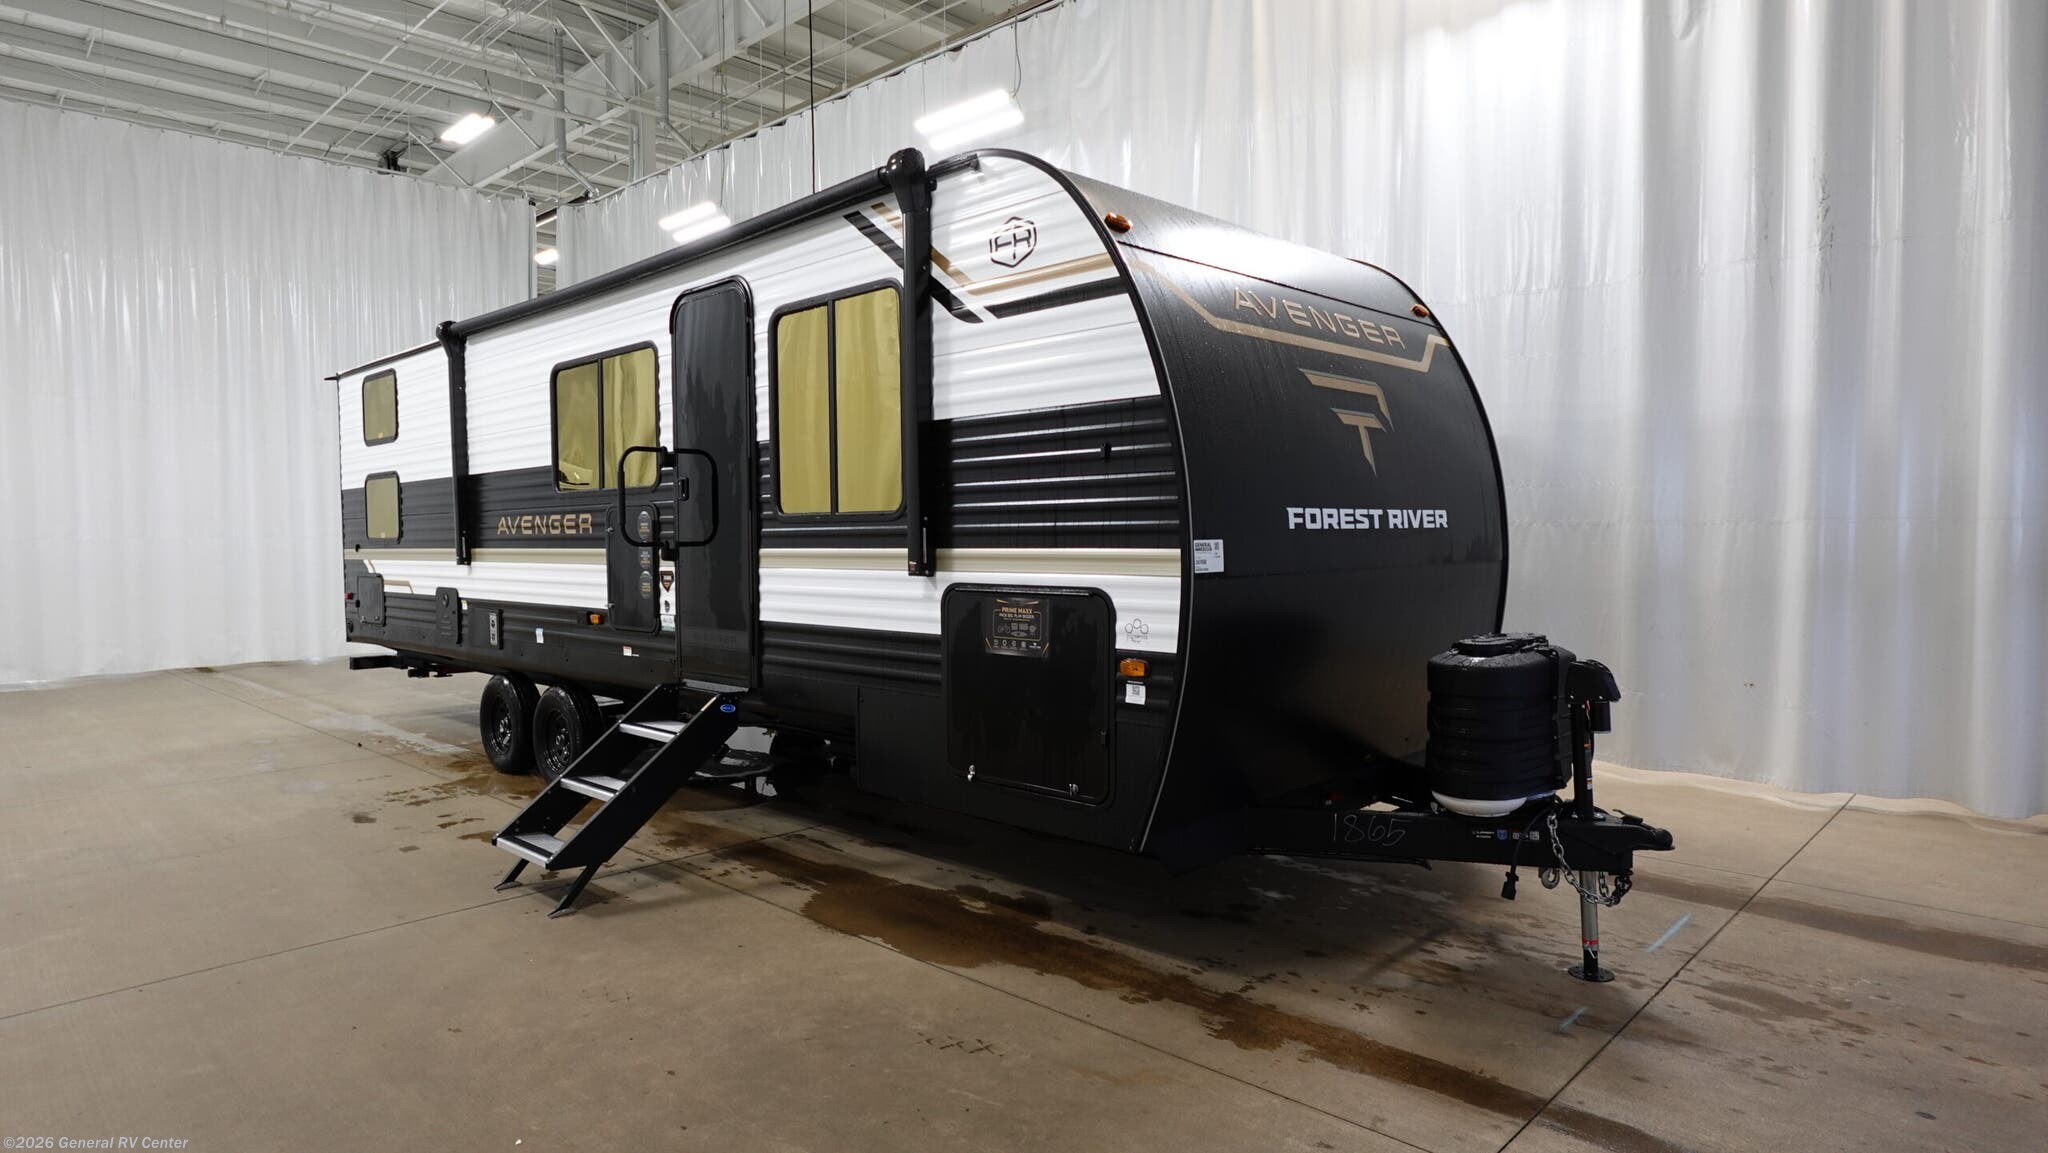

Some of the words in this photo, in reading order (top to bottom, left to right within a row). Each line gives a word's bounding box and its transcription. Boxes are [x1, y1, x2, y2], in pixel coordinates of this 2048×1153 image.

[1233, 286, 1406, 350] AVENGER
[497, 513, 593, 535] AVENGER
[1286, 507, 1383, 530] FOREST
[1387, 508, 1448, 529] RIVER
[1333, 812, 1406, 847] 1865
